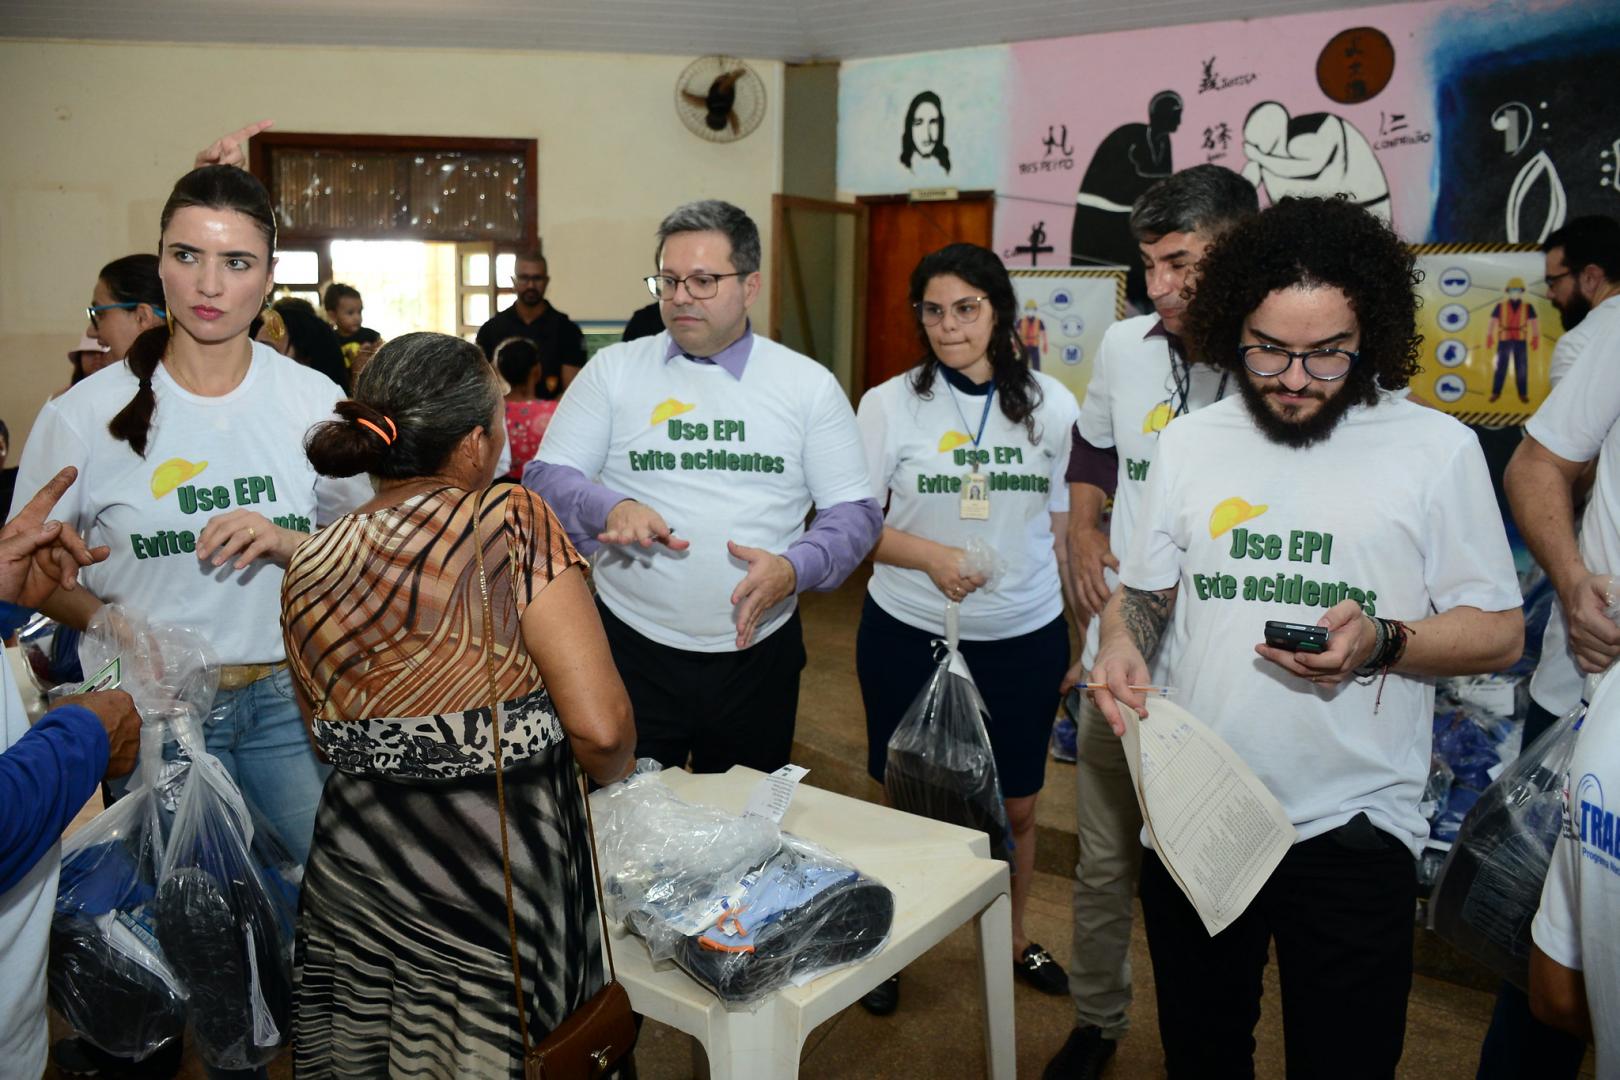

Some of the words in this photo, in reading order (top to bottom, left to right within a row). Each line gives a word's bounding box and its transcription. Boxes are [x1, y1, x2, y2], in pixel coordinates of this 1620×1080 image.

[668, 419, 708, 441] Use
[713, 420, 745, 442] EPI
[629, 450, 676, 471] Evite
[681, 449, 785, 474] acidentes
[953, 449, 990, 466] Use
[994, 446, 1023, 465] EPI
[178, 485, 231, 515] Use
[234, 475, 277, 506] EPI
[918, 474, 962, 494] Evite
[130, 530, 197, 560] Evite
[1230, 528, 1282, 560] Use
[1288, 530, 1333, 565] EPI
[1243, 573, 1377, 617] acidentes
